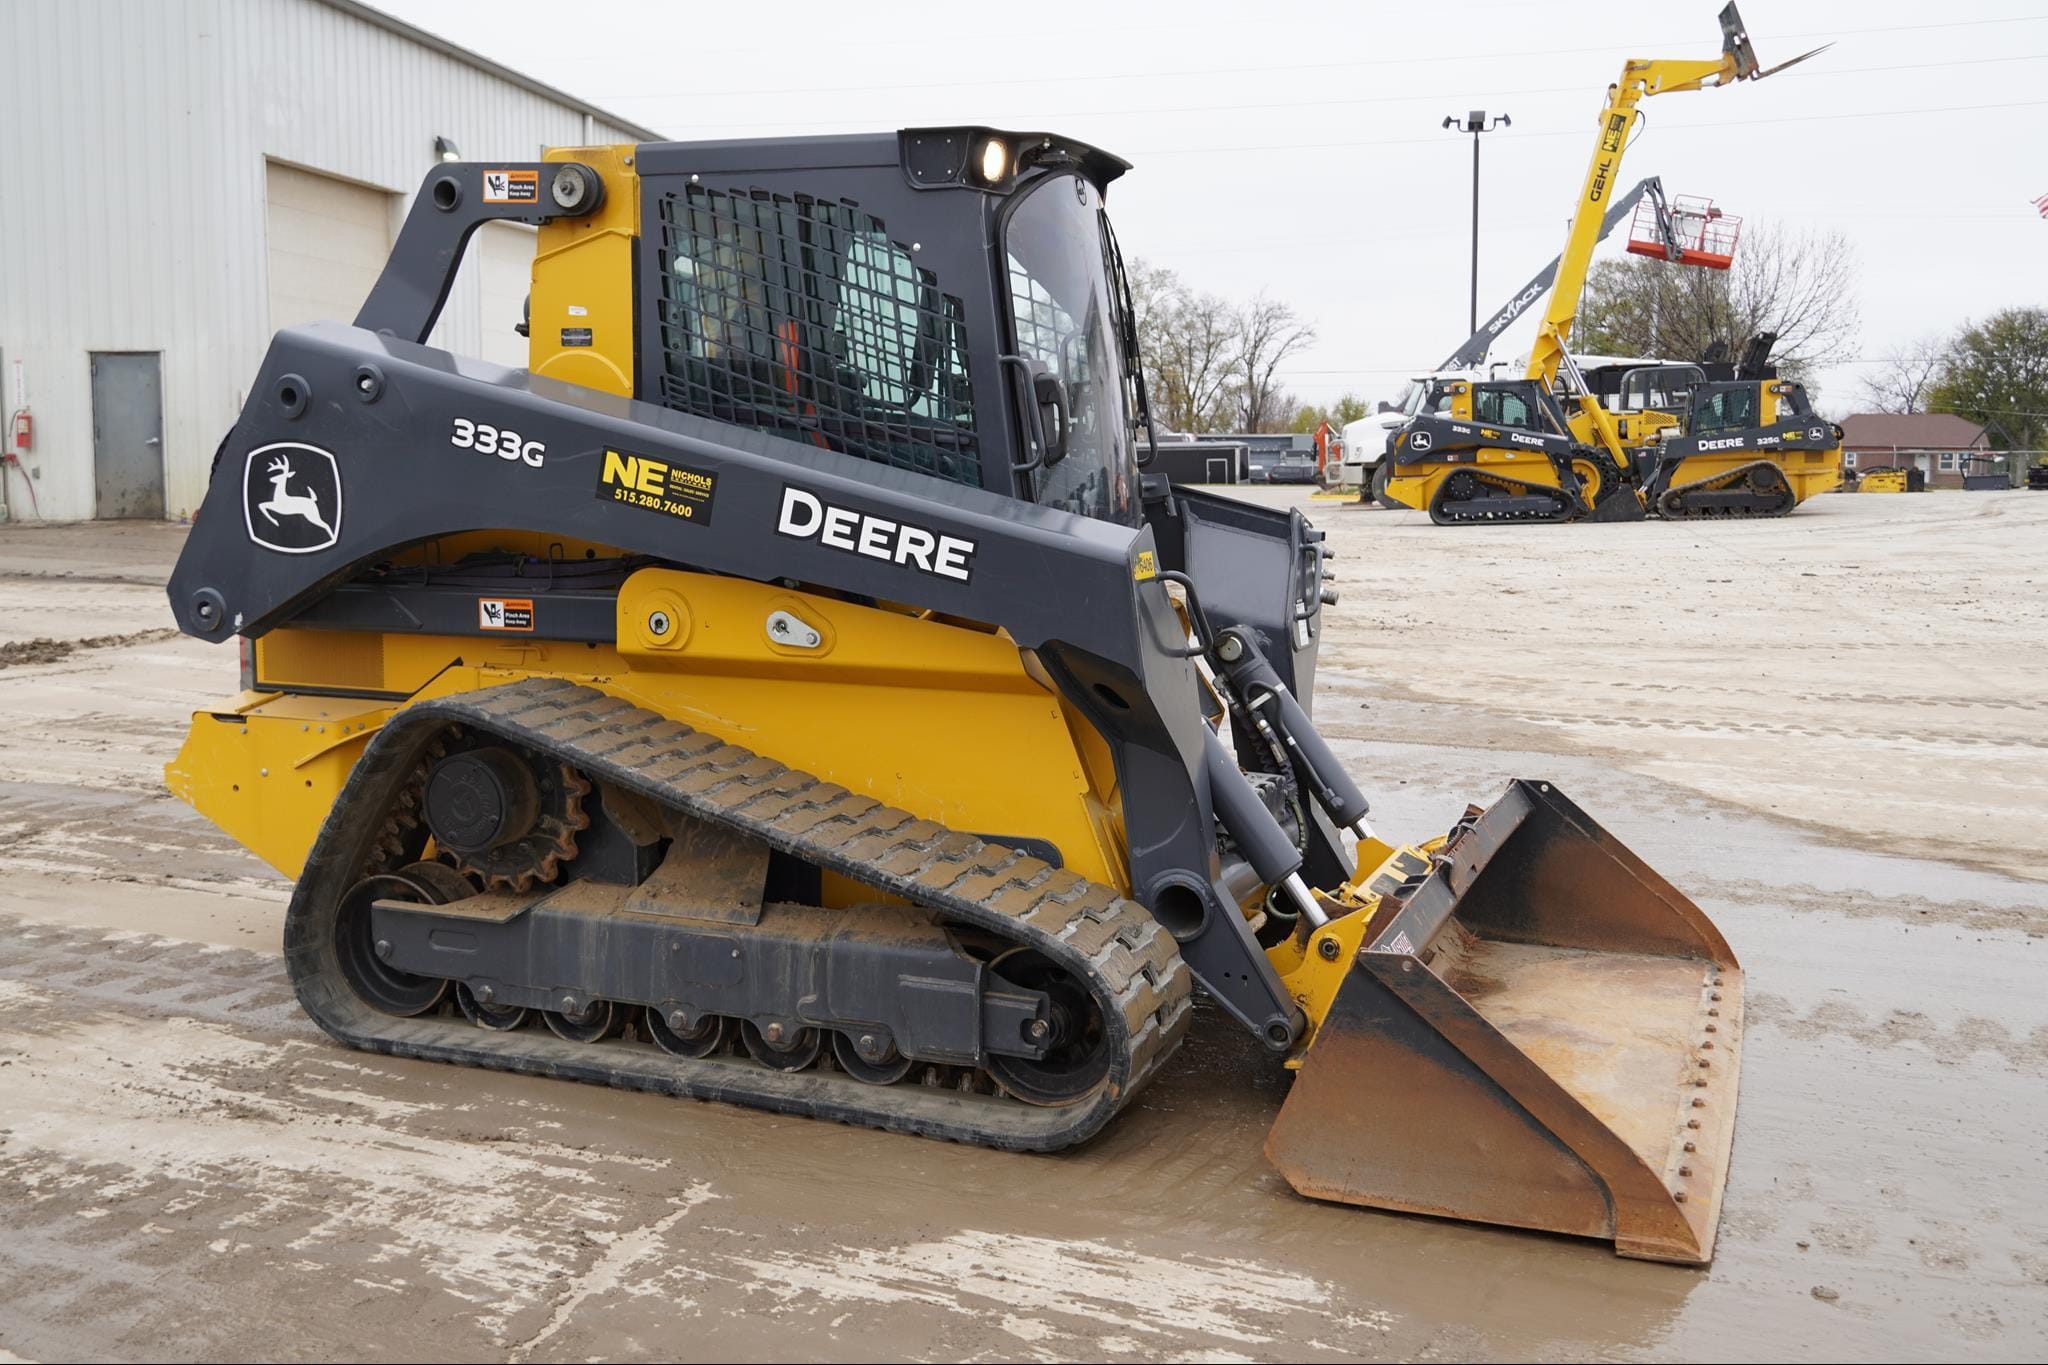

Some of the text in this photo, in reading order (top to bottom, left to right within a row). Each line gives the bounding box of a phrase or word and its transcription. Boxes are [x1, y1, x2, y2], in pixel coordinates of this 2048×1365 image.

[1590, 158, 1612, 202] GEHL
[1488, 283, 1543, 334] SKYJACK
[451, 418, 546, 468] 333G
[1511, 433, 1545, 447] DEERE
[1698, 437, 1744, 451] DEERE
[1757, 436, 1780, 446] 325G
[602, 450, 668, 496] NE
[671, 468, 712, 486] NICHOLS
[614, 488, 693, 518] 515.280.7600
[778, 487, 975, 581] DEERE
